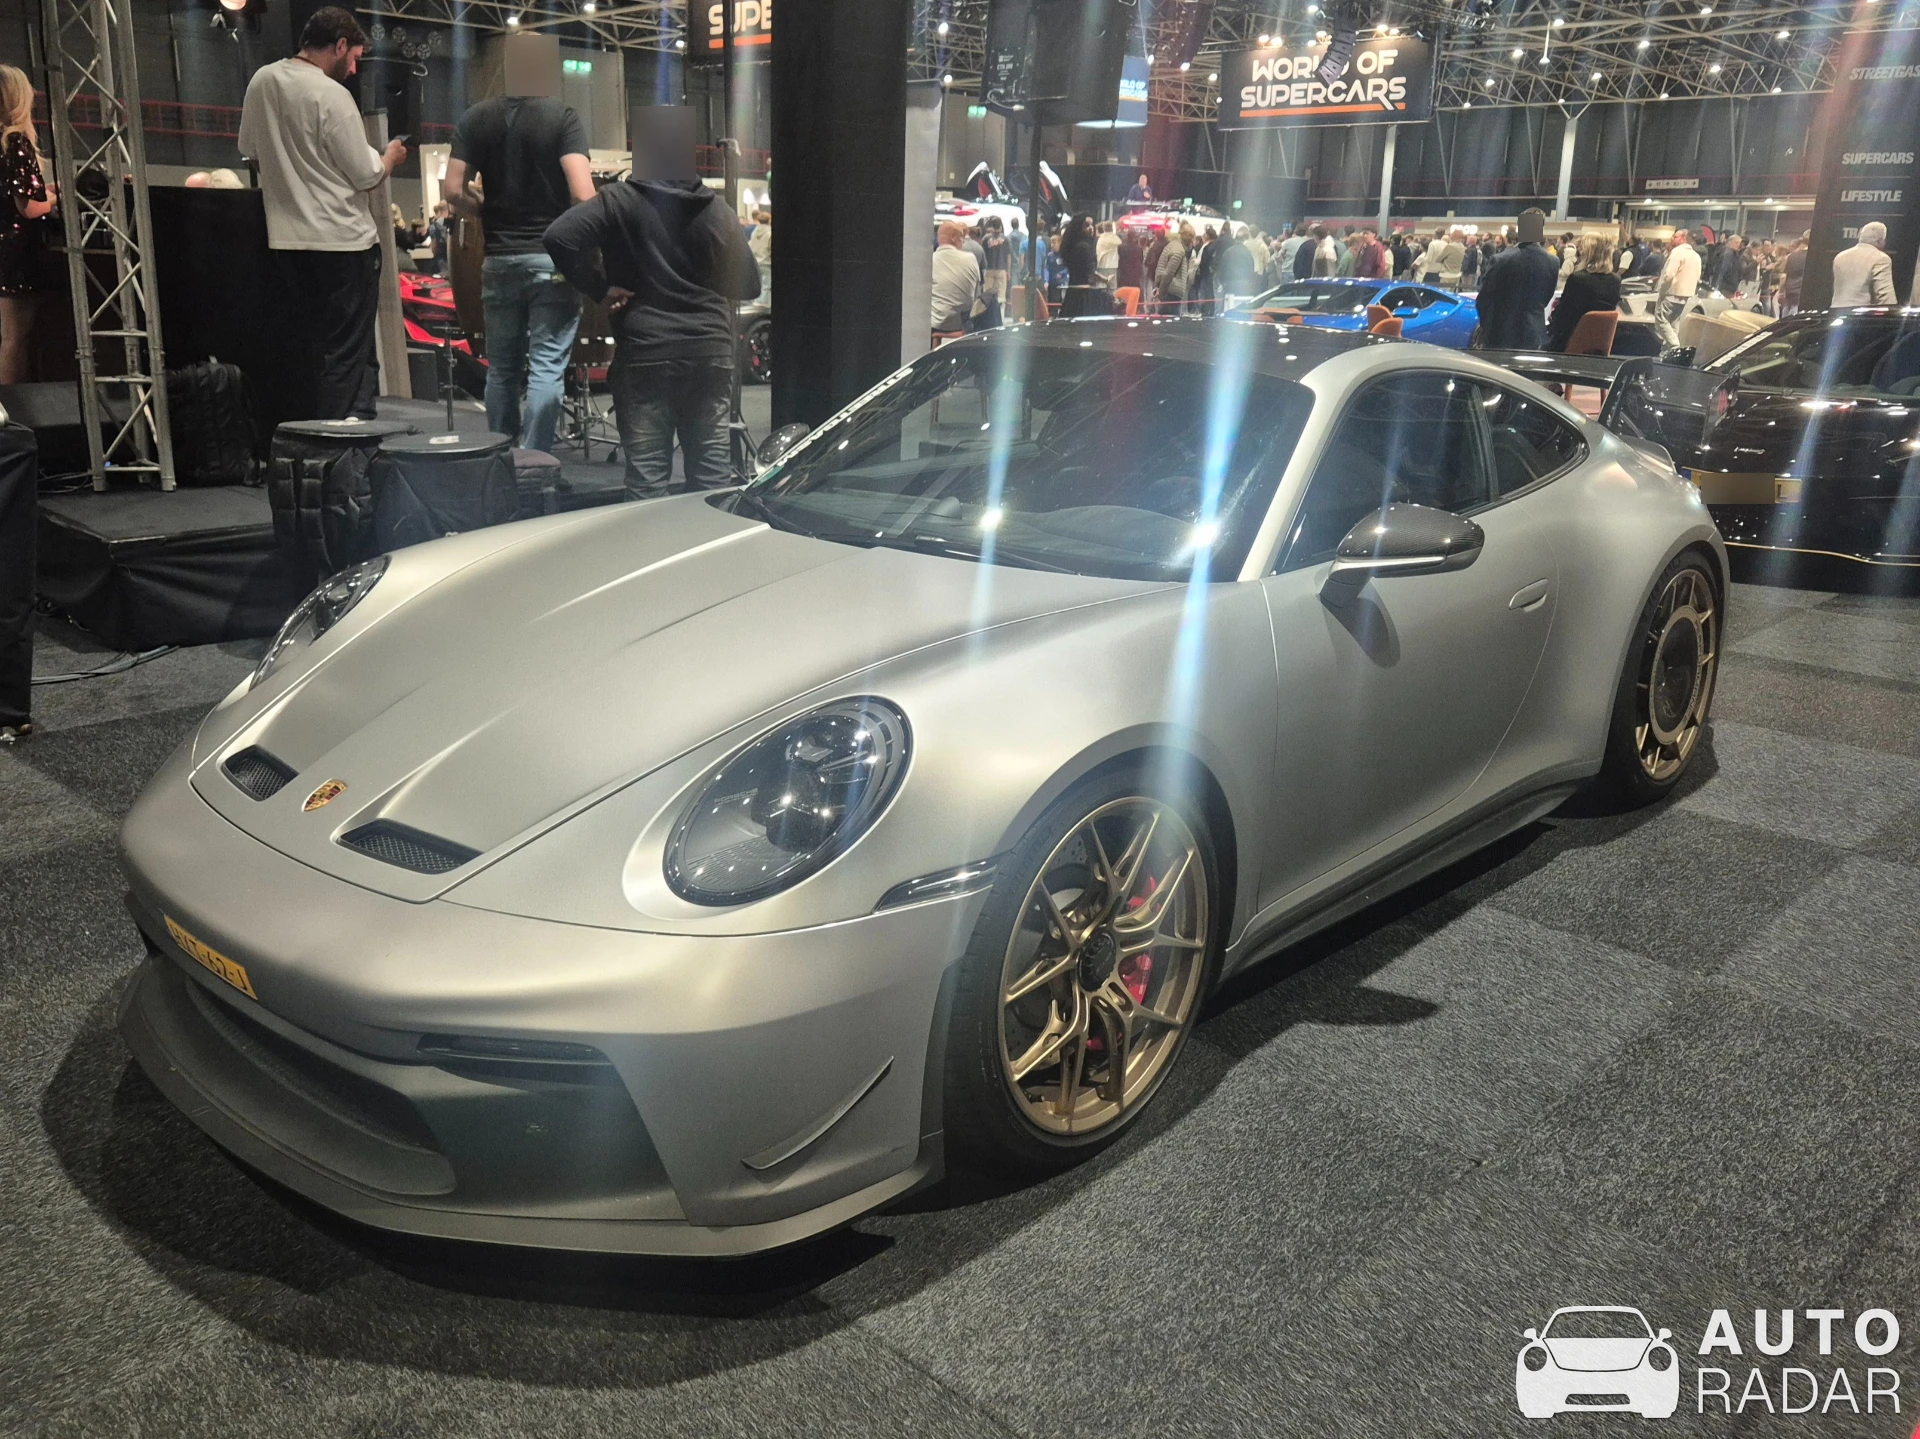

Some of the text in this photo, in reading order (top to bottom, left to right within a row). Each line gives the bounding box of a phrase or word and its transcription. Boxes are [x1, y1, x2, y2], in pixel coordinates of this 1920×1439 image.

[1252, 49, 1399, 82] WOR OF
[1240, 76, 1407, 110] SUPERCARS
[1842, 152, 1915, 165] SUPERCARS
[1840, 190, 1902, 202] LIFESTYLE
